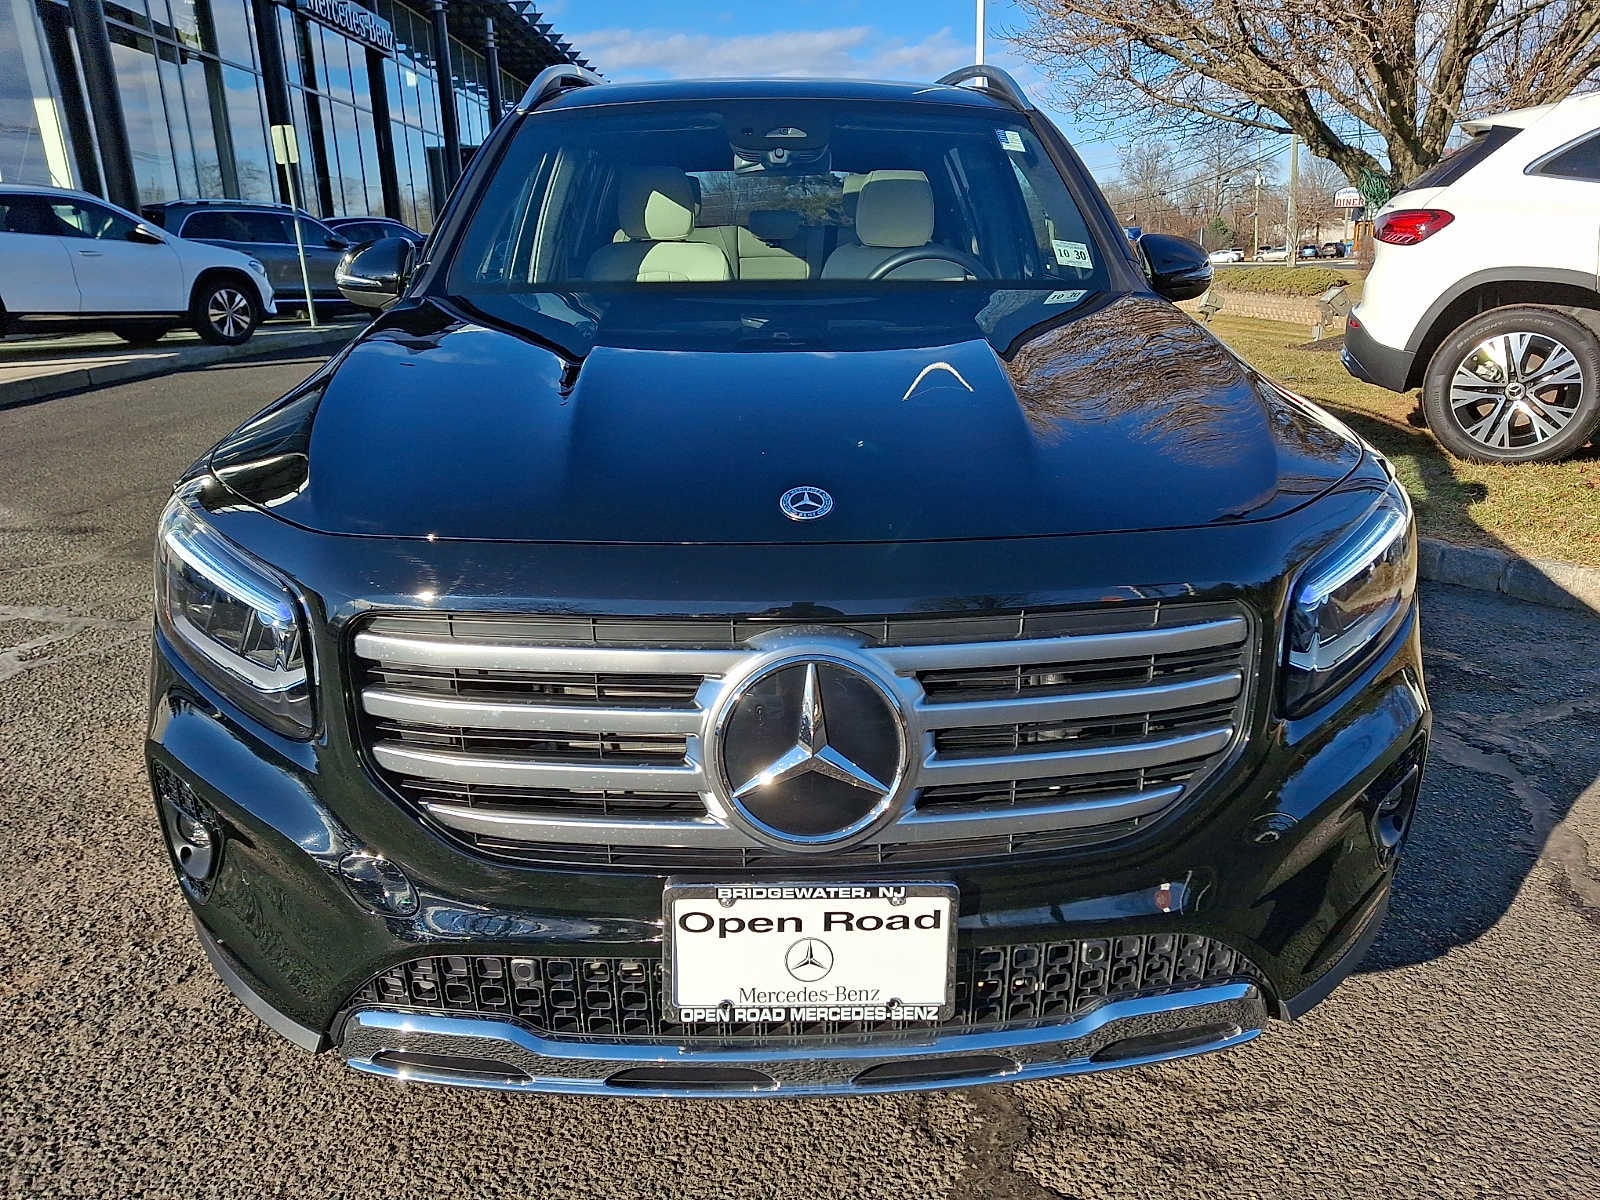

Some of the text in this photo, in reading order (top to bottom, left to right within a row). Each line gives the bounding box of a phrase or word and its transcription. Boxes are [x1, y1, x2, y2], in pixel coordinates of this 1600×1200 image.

[1058, 248, 1087, 260] 10 30
[717, 886, 906, 899] BRIDGEWATER, NJ
[678, 909, 942, 938] Open Road
[739, 985, 880, 1004] Mercedes-Benz
[680, 1006, 939, 1022] OPEN ROAD MERCEDES-BENZ
